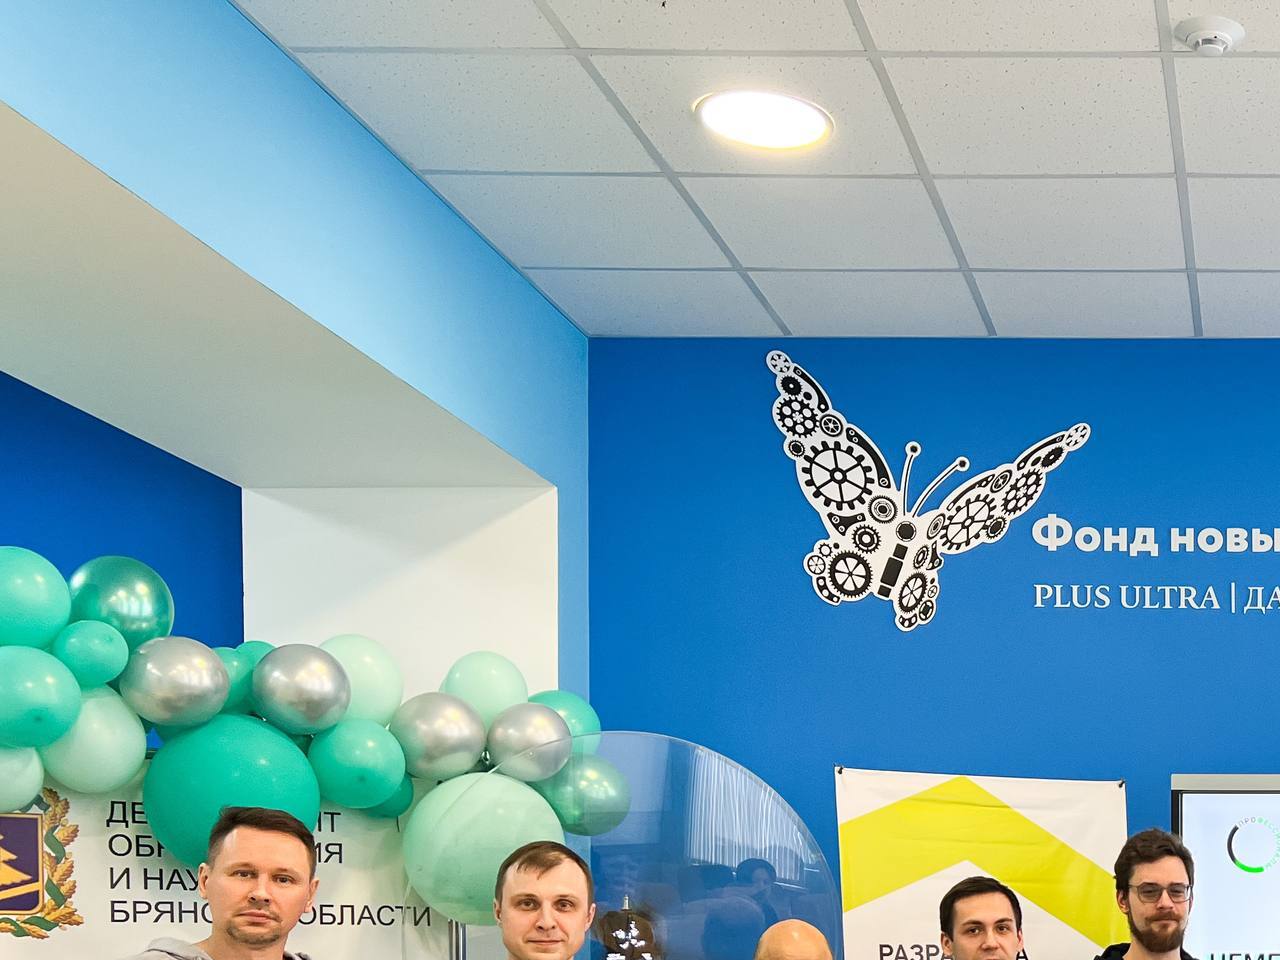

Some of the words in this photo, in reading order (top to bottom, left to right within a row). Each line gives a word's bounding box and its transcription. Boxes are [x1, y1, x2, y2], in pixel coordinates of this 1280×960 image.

[1031, 506, 1158, 556] Фонд
[1033, 585, 1110, 609] PLUS
[1119, 585, 1221, 610] ULTRA
[109, 867, 130, 890] И
[143, 868, 199, 891] НАУ
